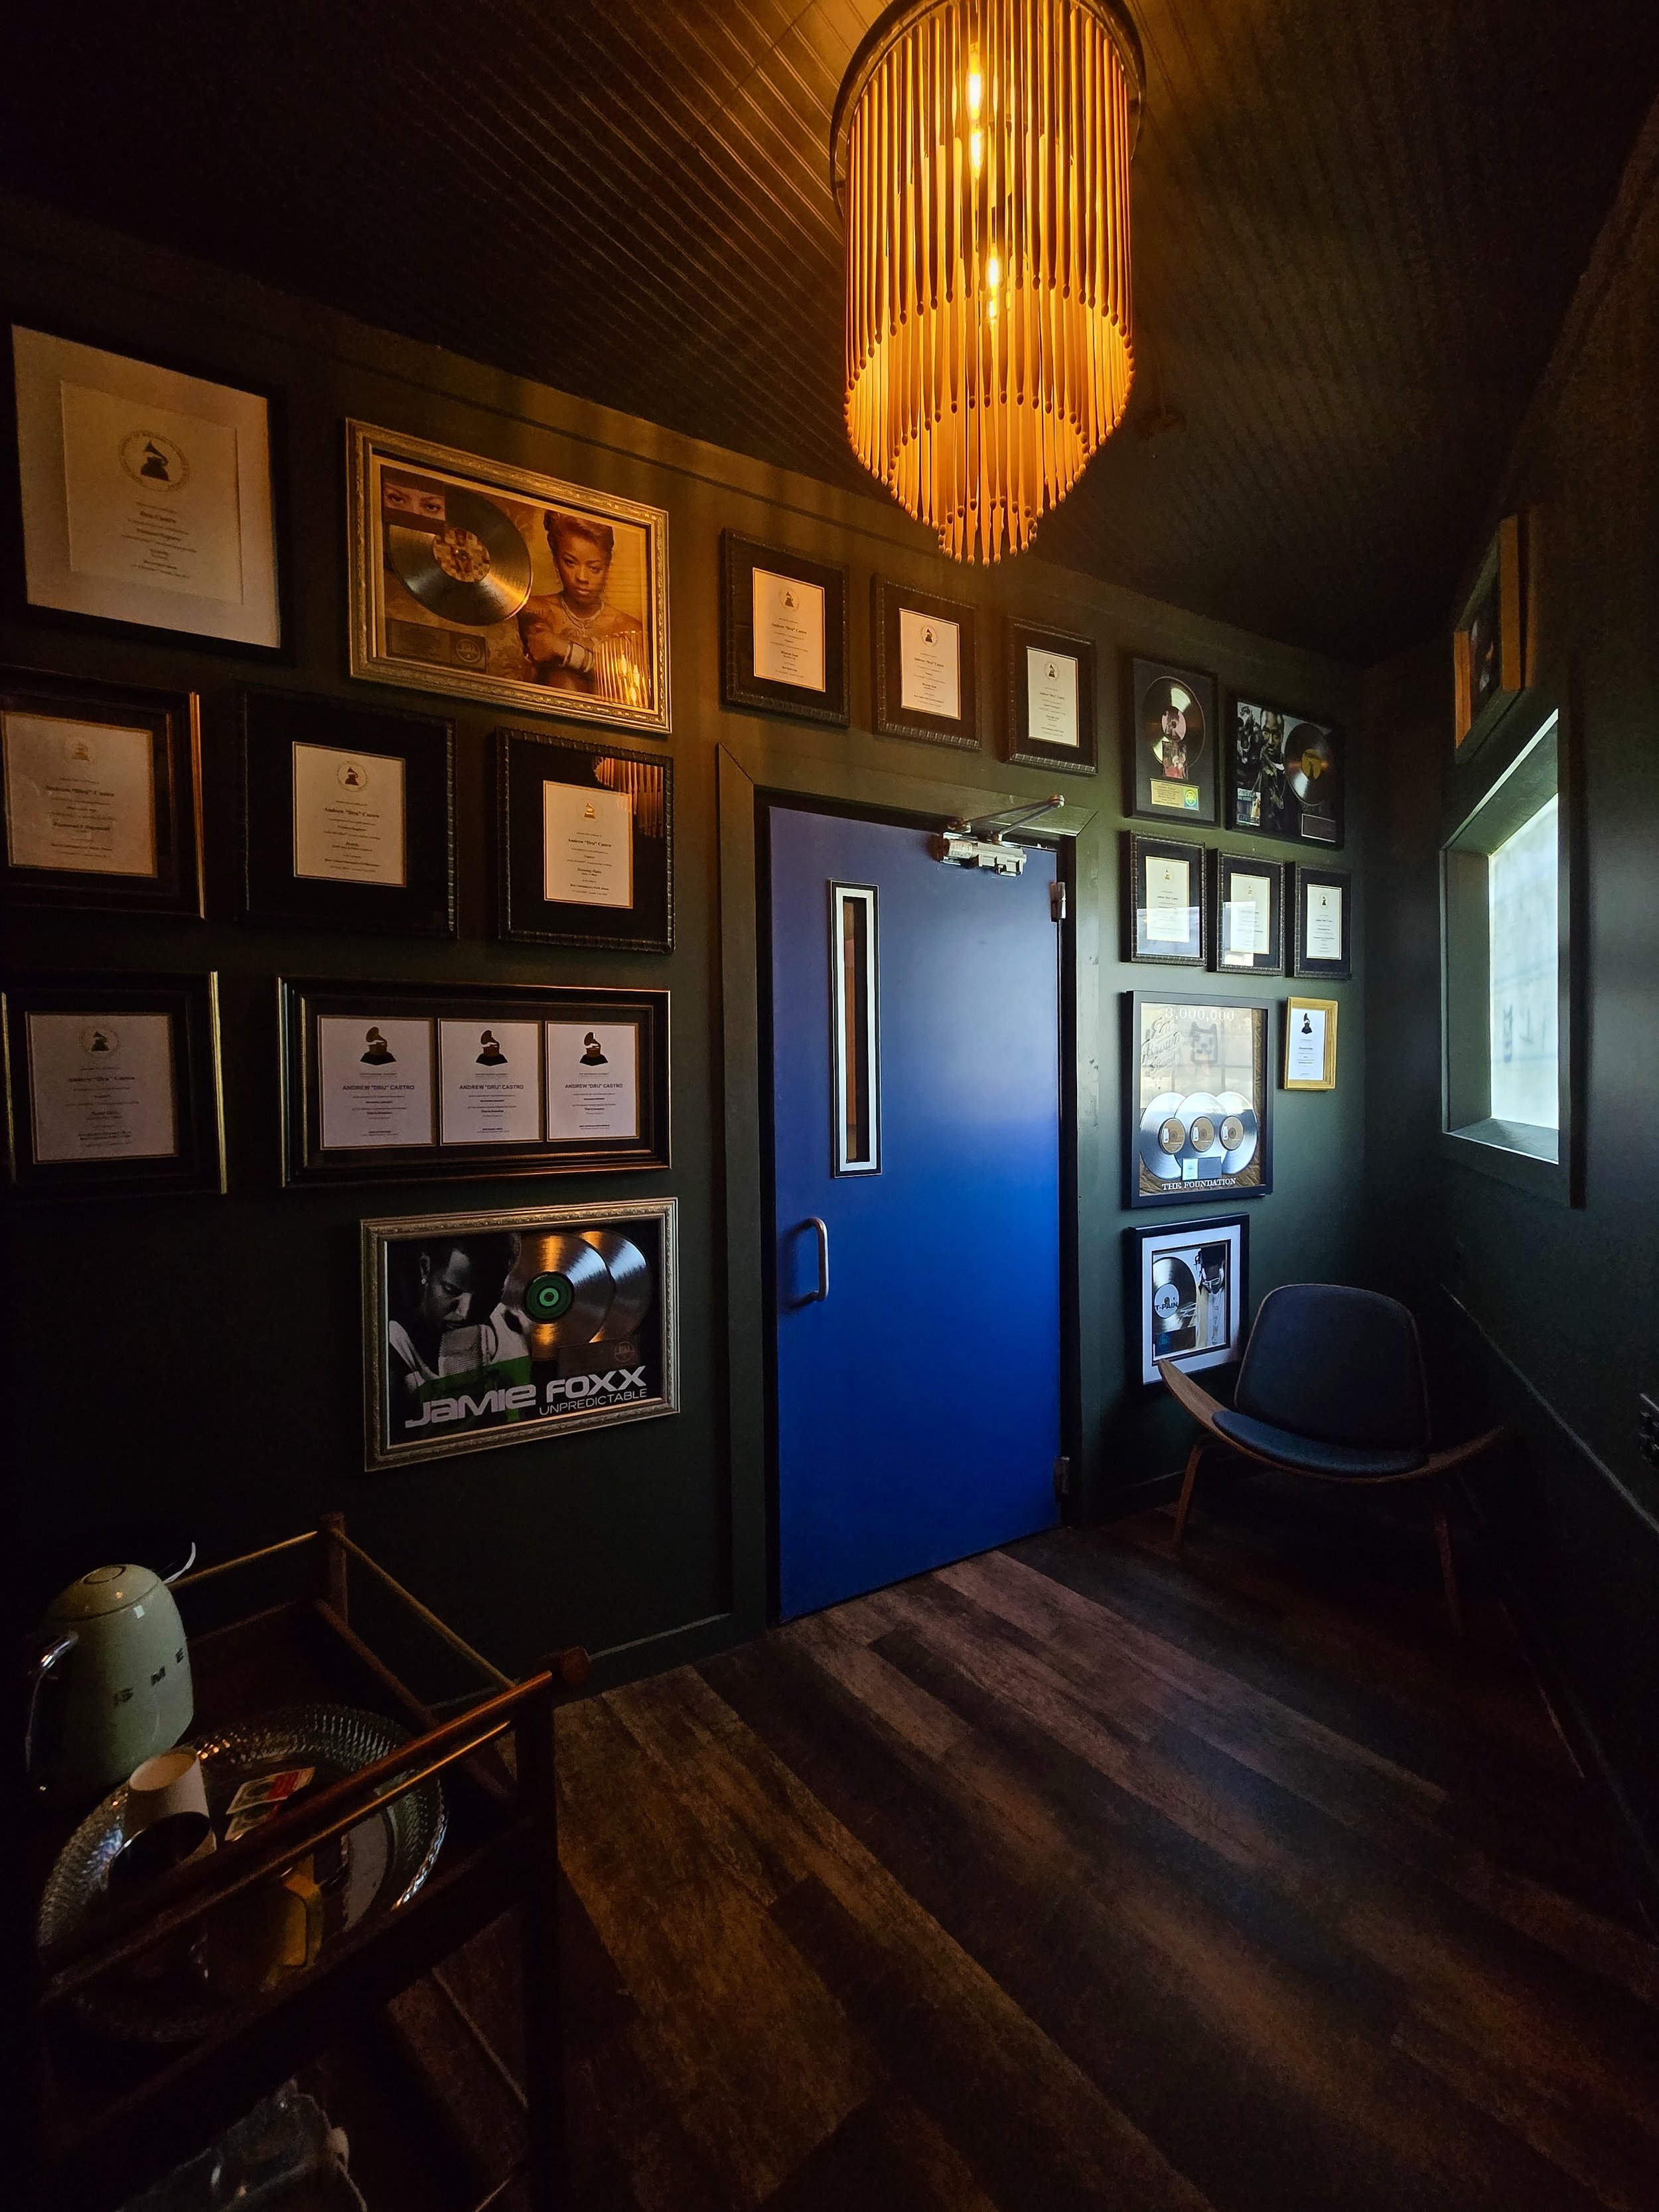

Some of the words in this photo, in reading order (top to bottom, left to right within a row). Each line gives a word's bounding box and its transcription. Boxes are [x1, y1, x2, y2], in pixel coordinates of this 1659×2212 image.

[1165, 1007, 1235, 1022] 3,000,000
[1161, 1182, 1182, 1191] THE
[1183, 1177, 1237, 1189] FOUNDATION
[1155, 1301, 1178, 1311] T-PAIN
[546, 1365, 647, 1403] FOXX
[540, 1388, 648, 1416] UNPREDICTABLE
